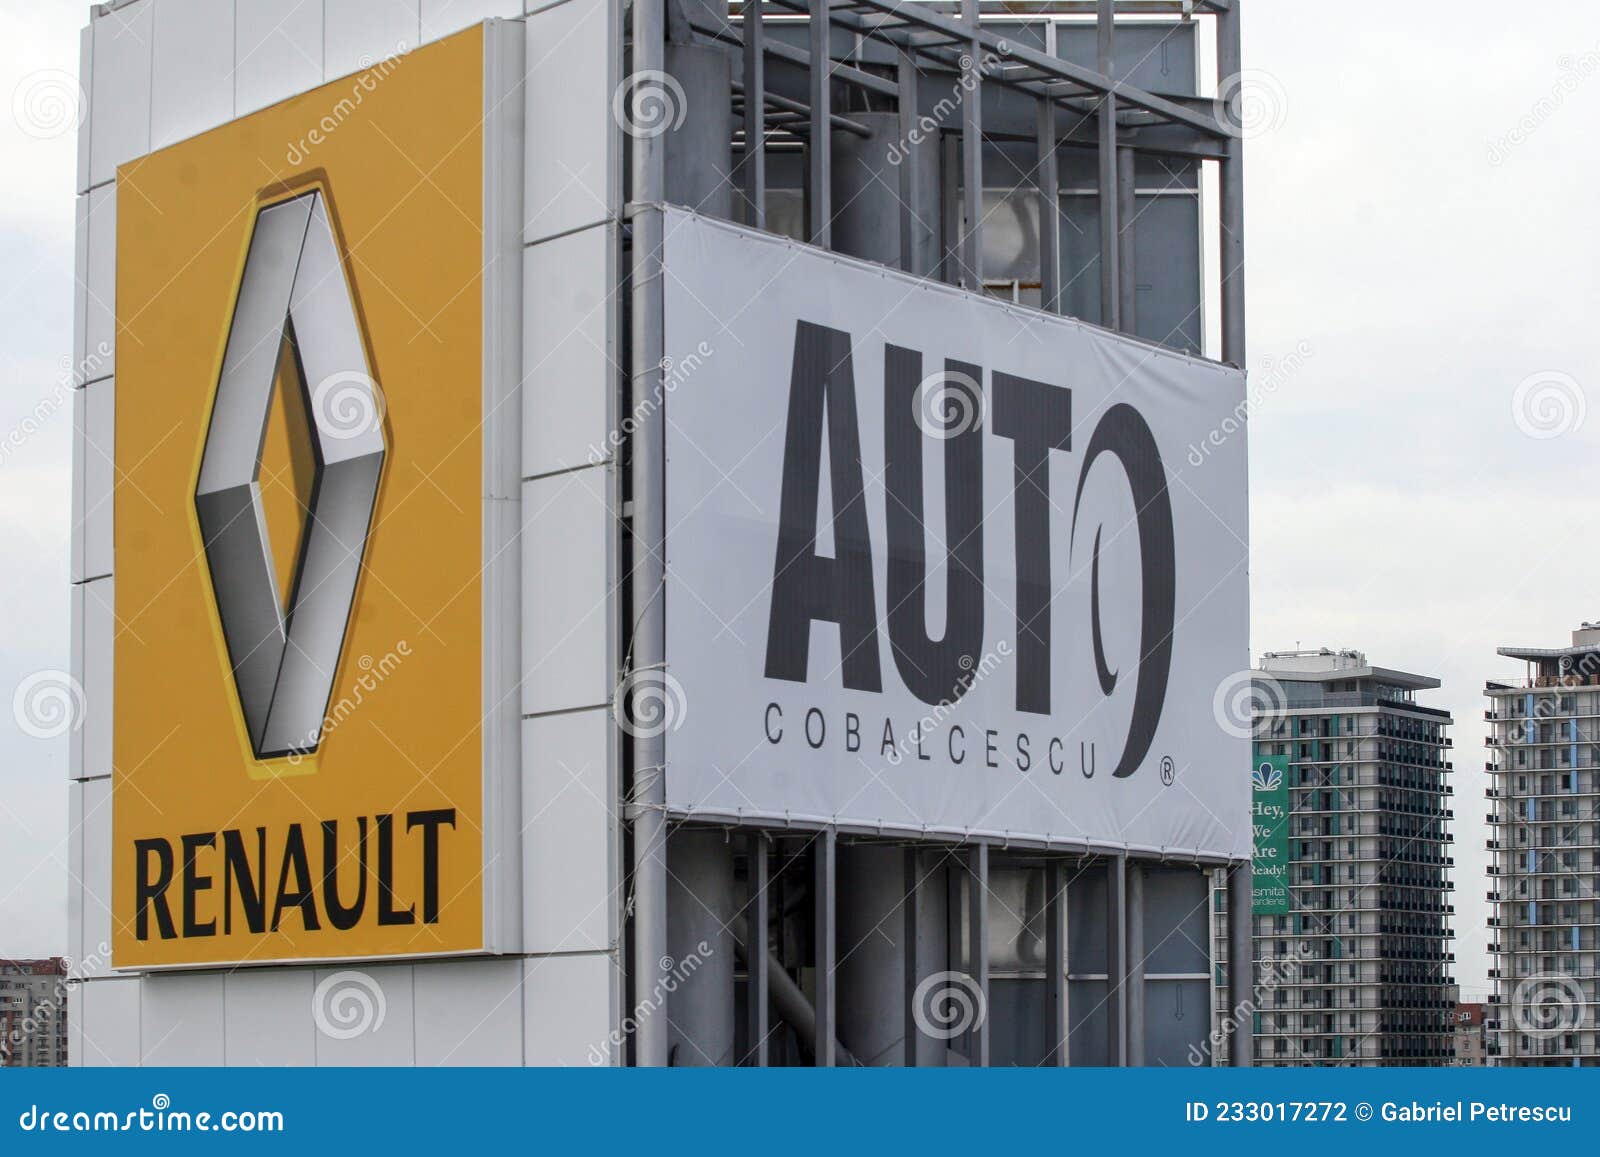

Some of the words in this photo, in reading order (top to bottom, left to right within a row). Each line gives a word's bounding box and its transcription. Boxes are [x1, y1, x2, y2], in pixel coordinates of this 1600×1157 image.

[764, 319, 1176, 779] AUTO
[764, 703, 1096, 779] COBALCESCU
[1250, 801, 1284, 820] Hey,
[134, 808, 456, 941] RENAULT
